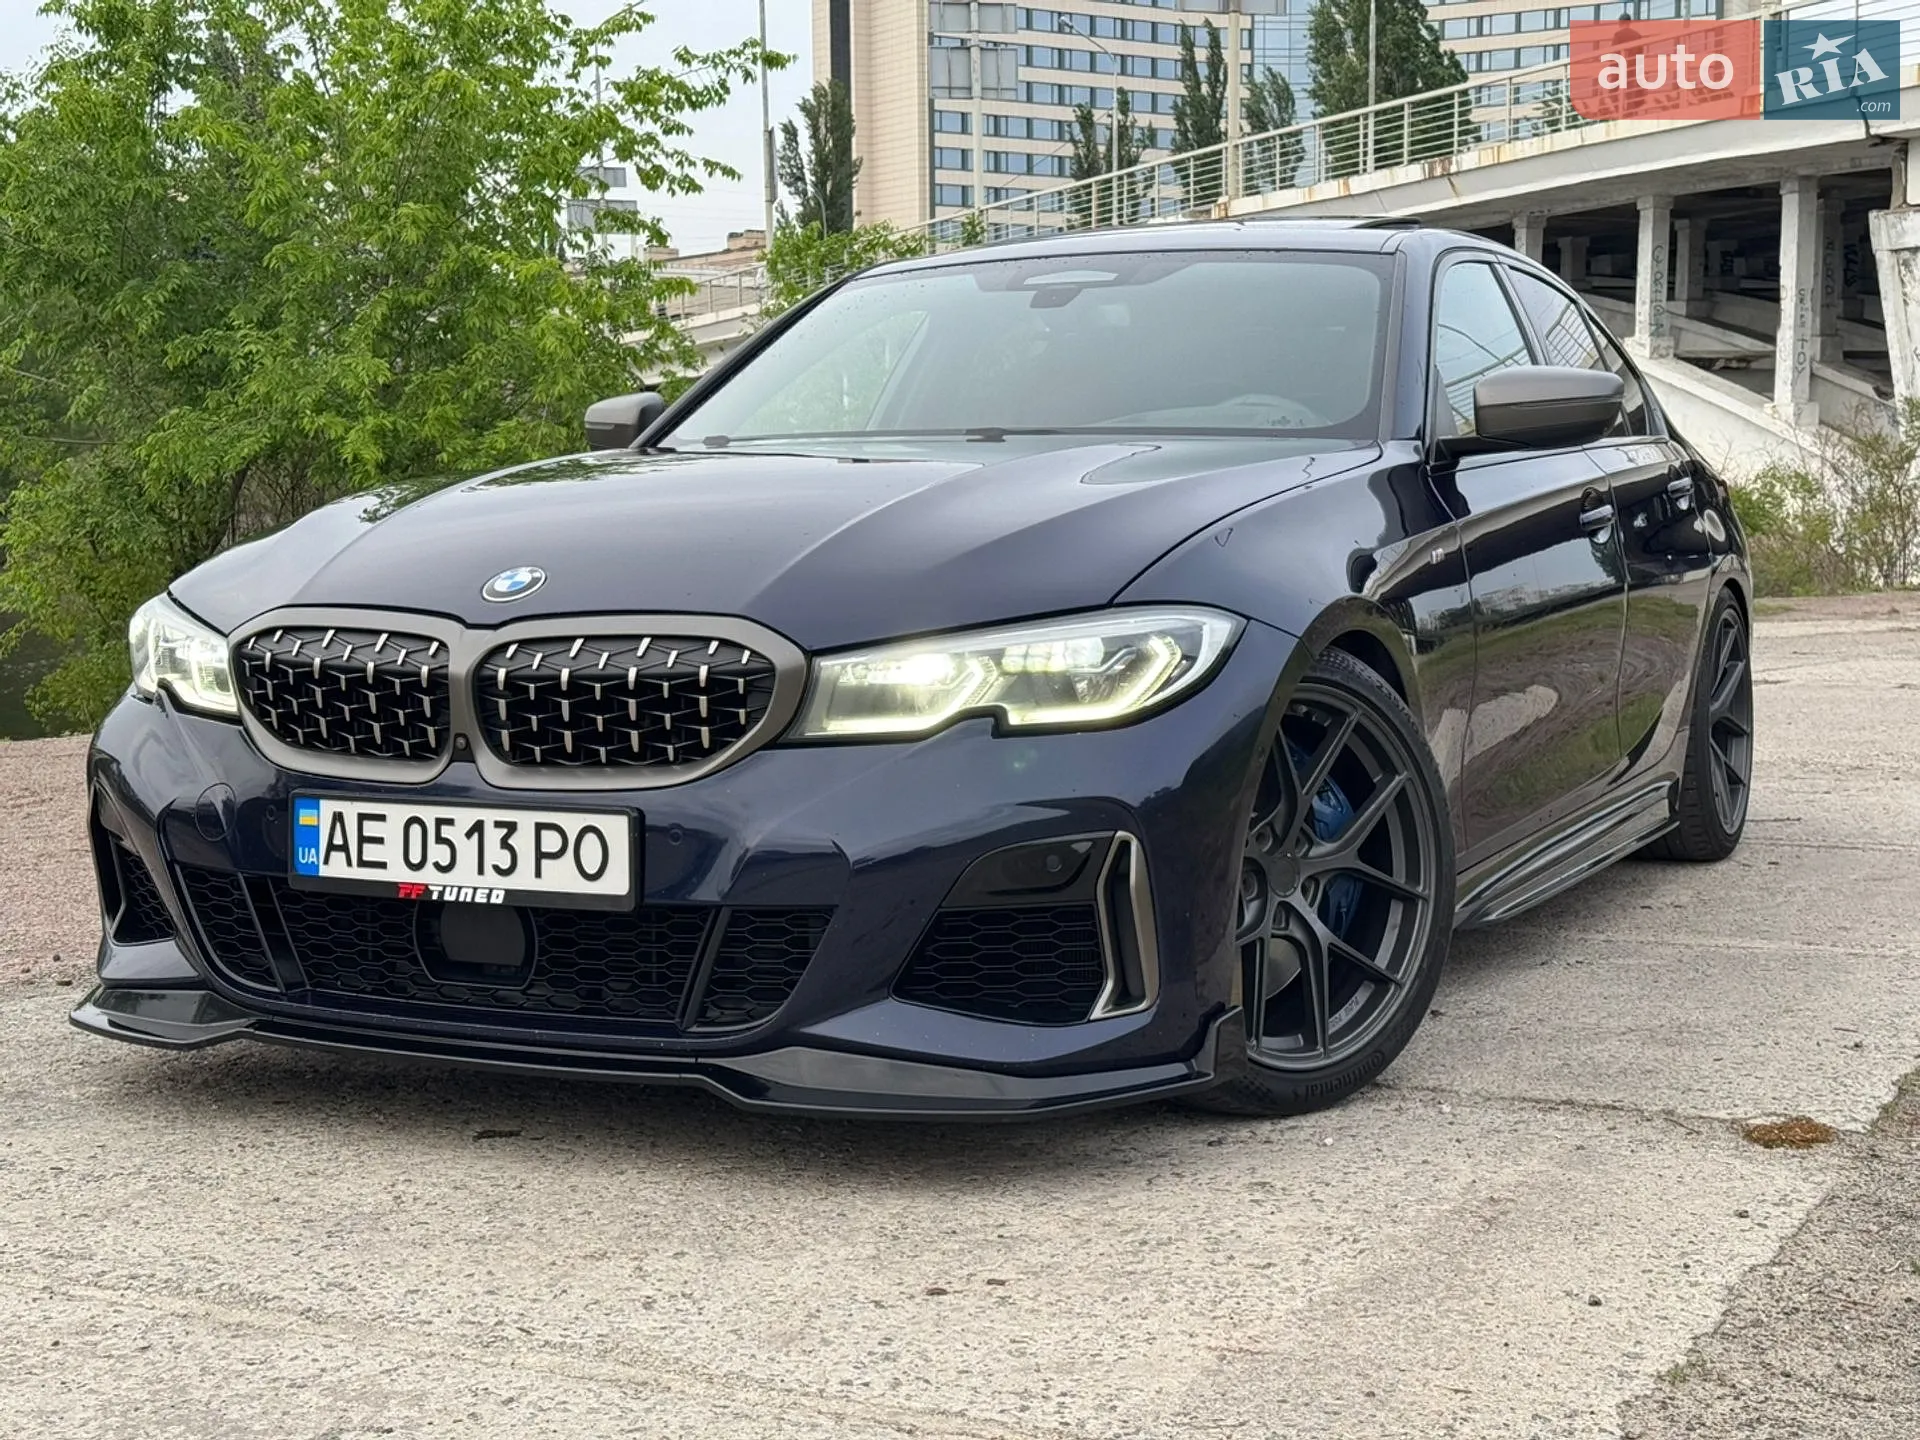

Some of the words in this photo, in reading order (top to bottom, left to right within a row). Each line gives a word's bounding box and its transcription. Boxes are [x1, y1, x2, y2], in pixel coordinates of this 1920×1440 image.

[322, 810, 388, 870] AE
[402, 815, 518, 877] 0513
[534, 821, 609, 882] PO
[299, 847, 318, 865] UA
[428, 885, 506, 904] TUNED
